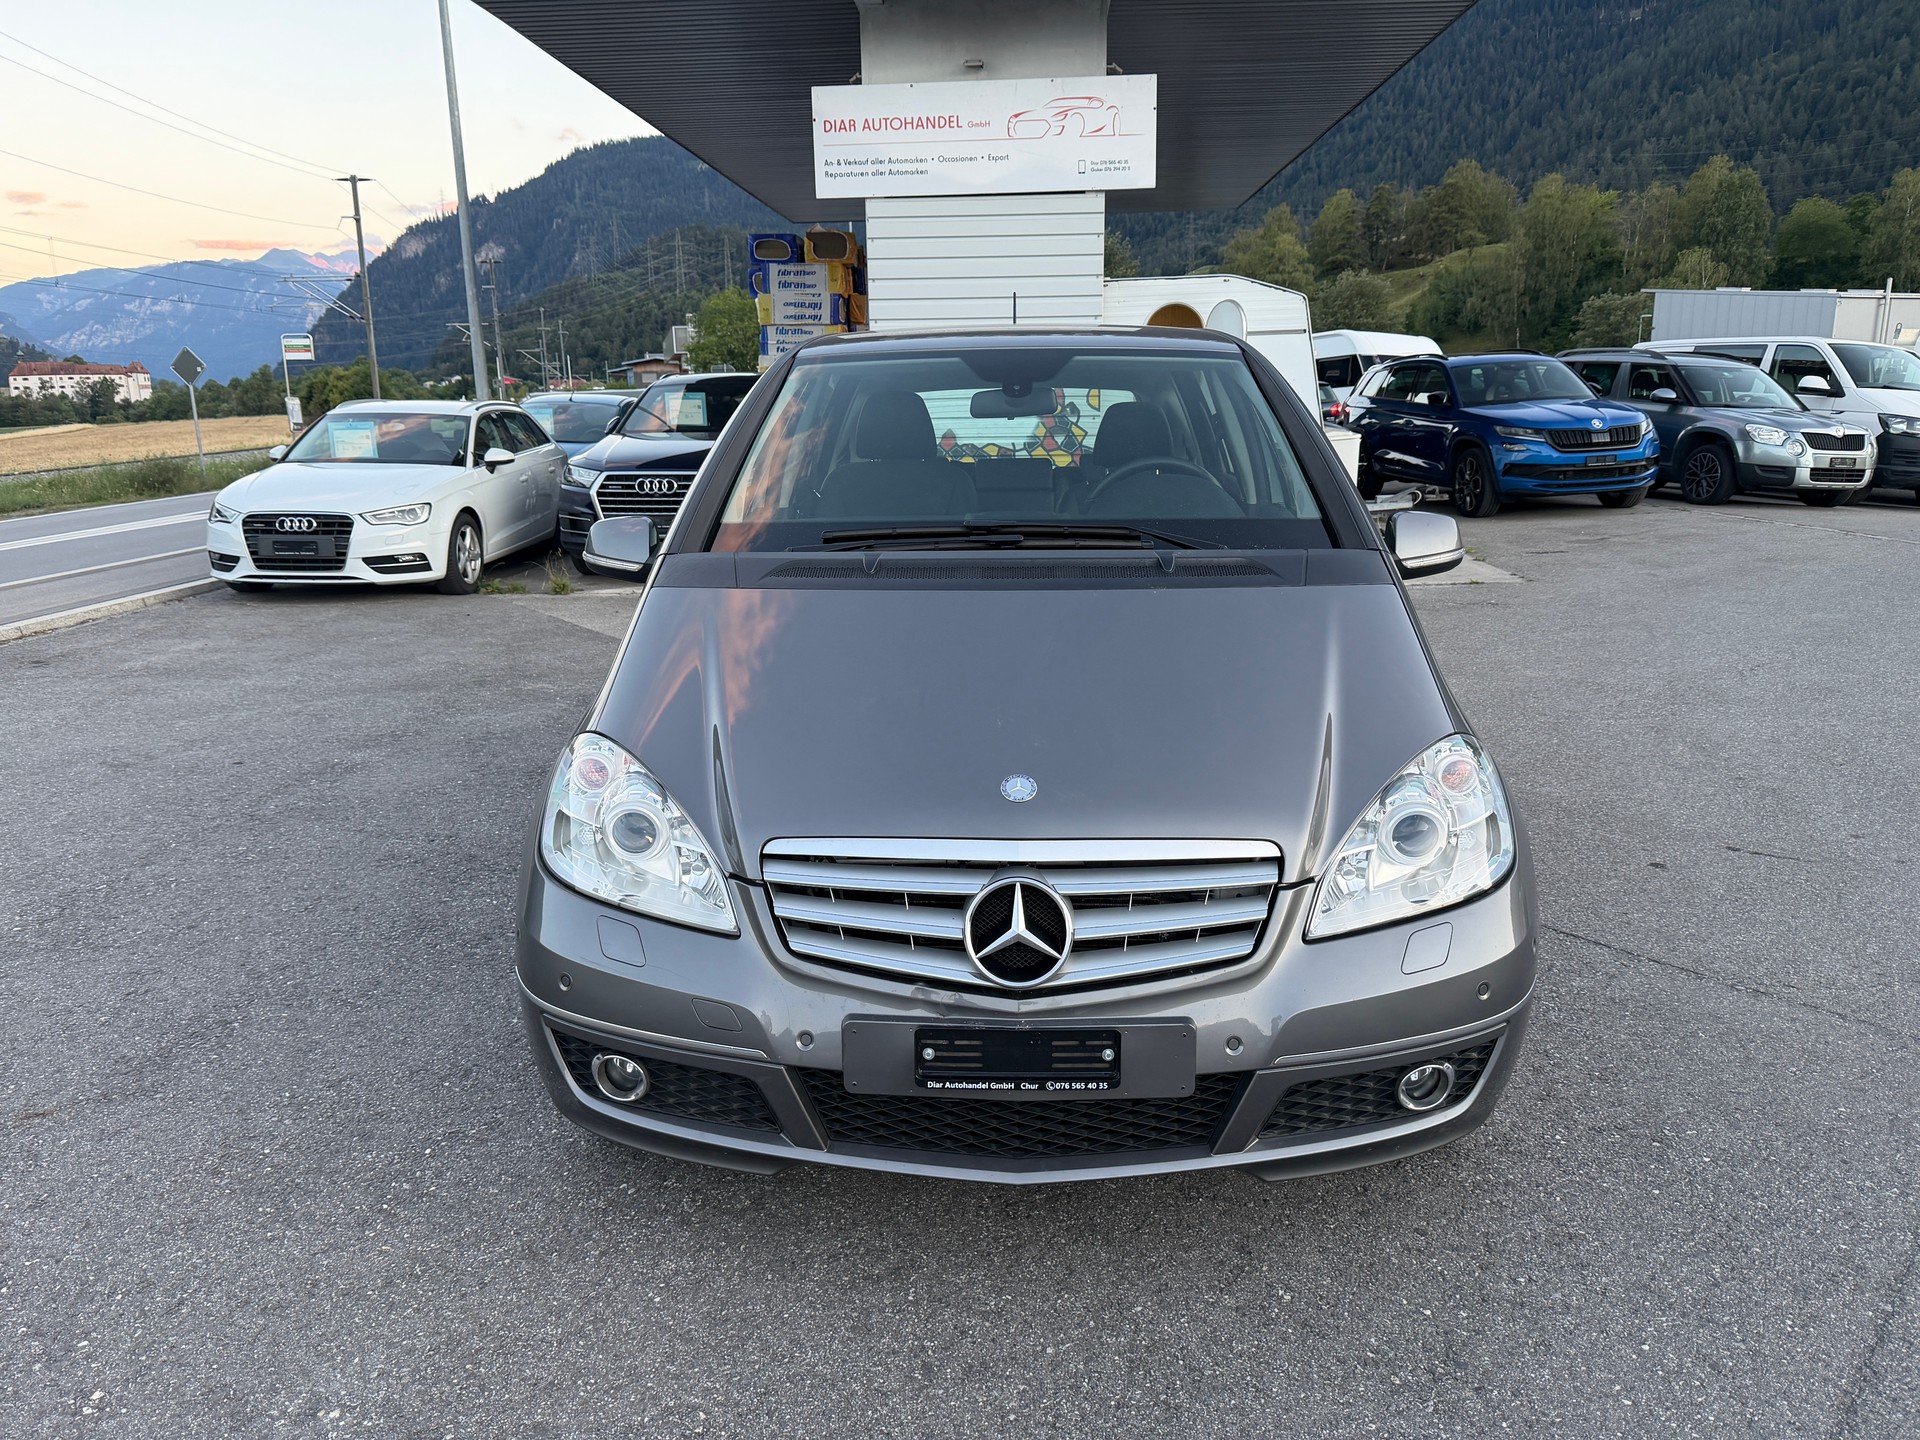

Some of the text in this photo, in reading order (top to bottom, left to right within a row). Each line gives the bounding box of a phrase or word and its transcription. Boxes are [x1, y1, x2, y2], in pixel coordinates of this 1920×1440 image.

[823, 115, 991, 133] DIAR AUTOHANDEL GmbH
[843, 157, 869, 167] Verkauf
[870, 157, 886, 166] aller
[887, 156, 928, 165] Automarken
[937, 154, 978, 163] Occasionen
[987, 153, 1010, 162] Export
[824, 167, 928, 180] Reparaturen aller Automarken
[927, 1081, 1108, 1090] Diar Autohandel GmbH Chur 076 565 40 35
